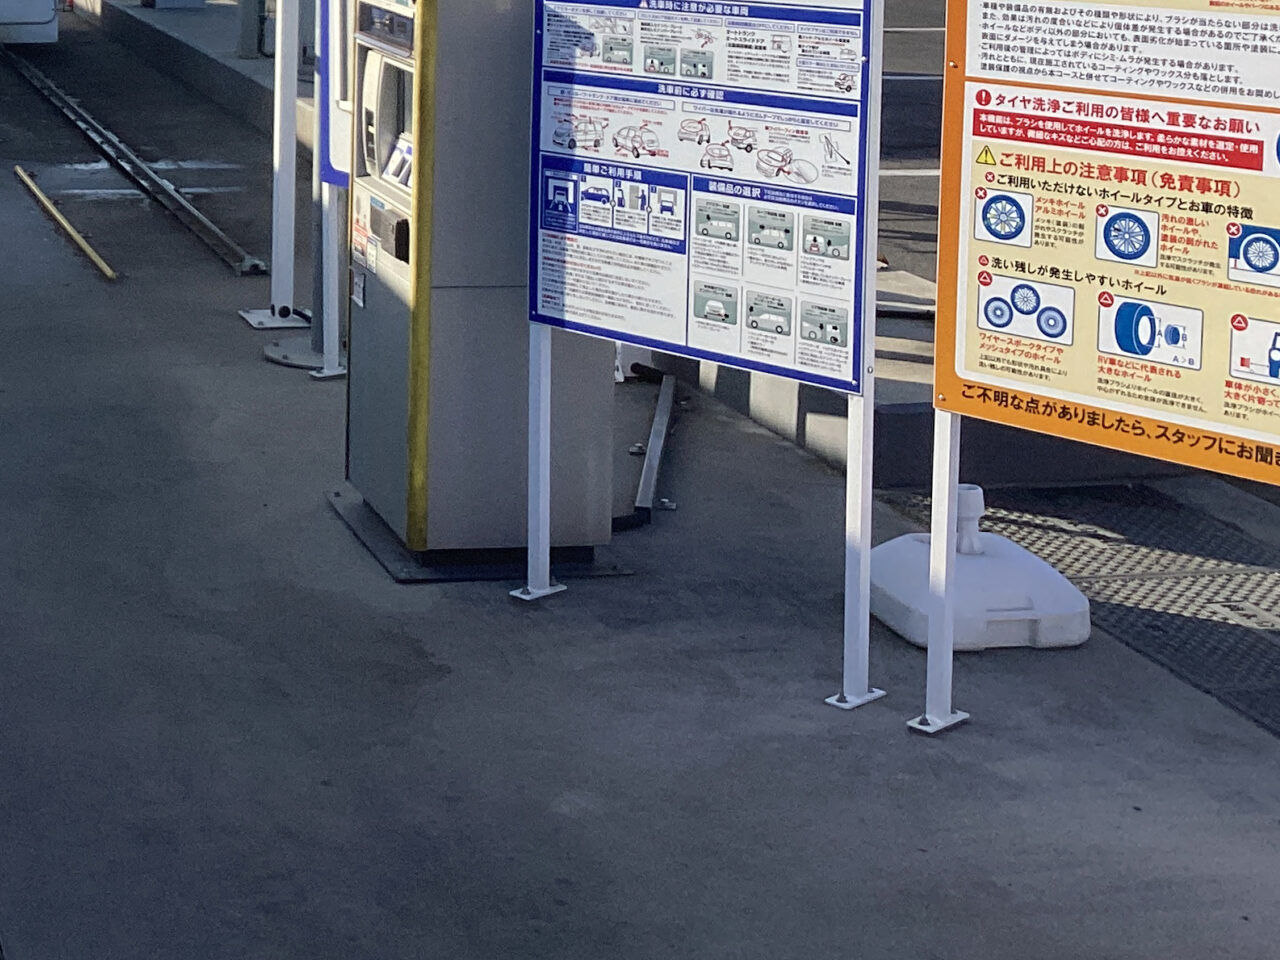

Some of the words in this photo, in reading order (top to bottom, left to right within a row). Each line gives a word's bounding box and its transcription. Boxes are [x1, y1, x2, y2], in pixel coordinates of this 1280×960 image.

[658, 83, 724, 101] 洗車前に必ず確認
[995, 93, 1261, 135] タイヤ洗浄ご利用の皆様へ重要なお願い
[708, 181, 761, 199] 装備品の選択
[996, 173, 1254, 221] ご利用いただけないホイールタイプとお車の特徴
[1035, 197, 1086, 210] メッキホイール
[1035, 205, 1086, 220] アルミホイール
[1161, 213, 1210, 228] 汚れの激しい
[1160, 244, 1190, 255] ホイール
[991, 256, 1167, 296] 洗い残しが発生しやすいホイール
[979, 332, 1064, 355] ワイヤースポークタイプや
[979, 342, 1061, 365] メッシュタイプのホイール
[1097, 366, 1152, 382] 大きなホイール
